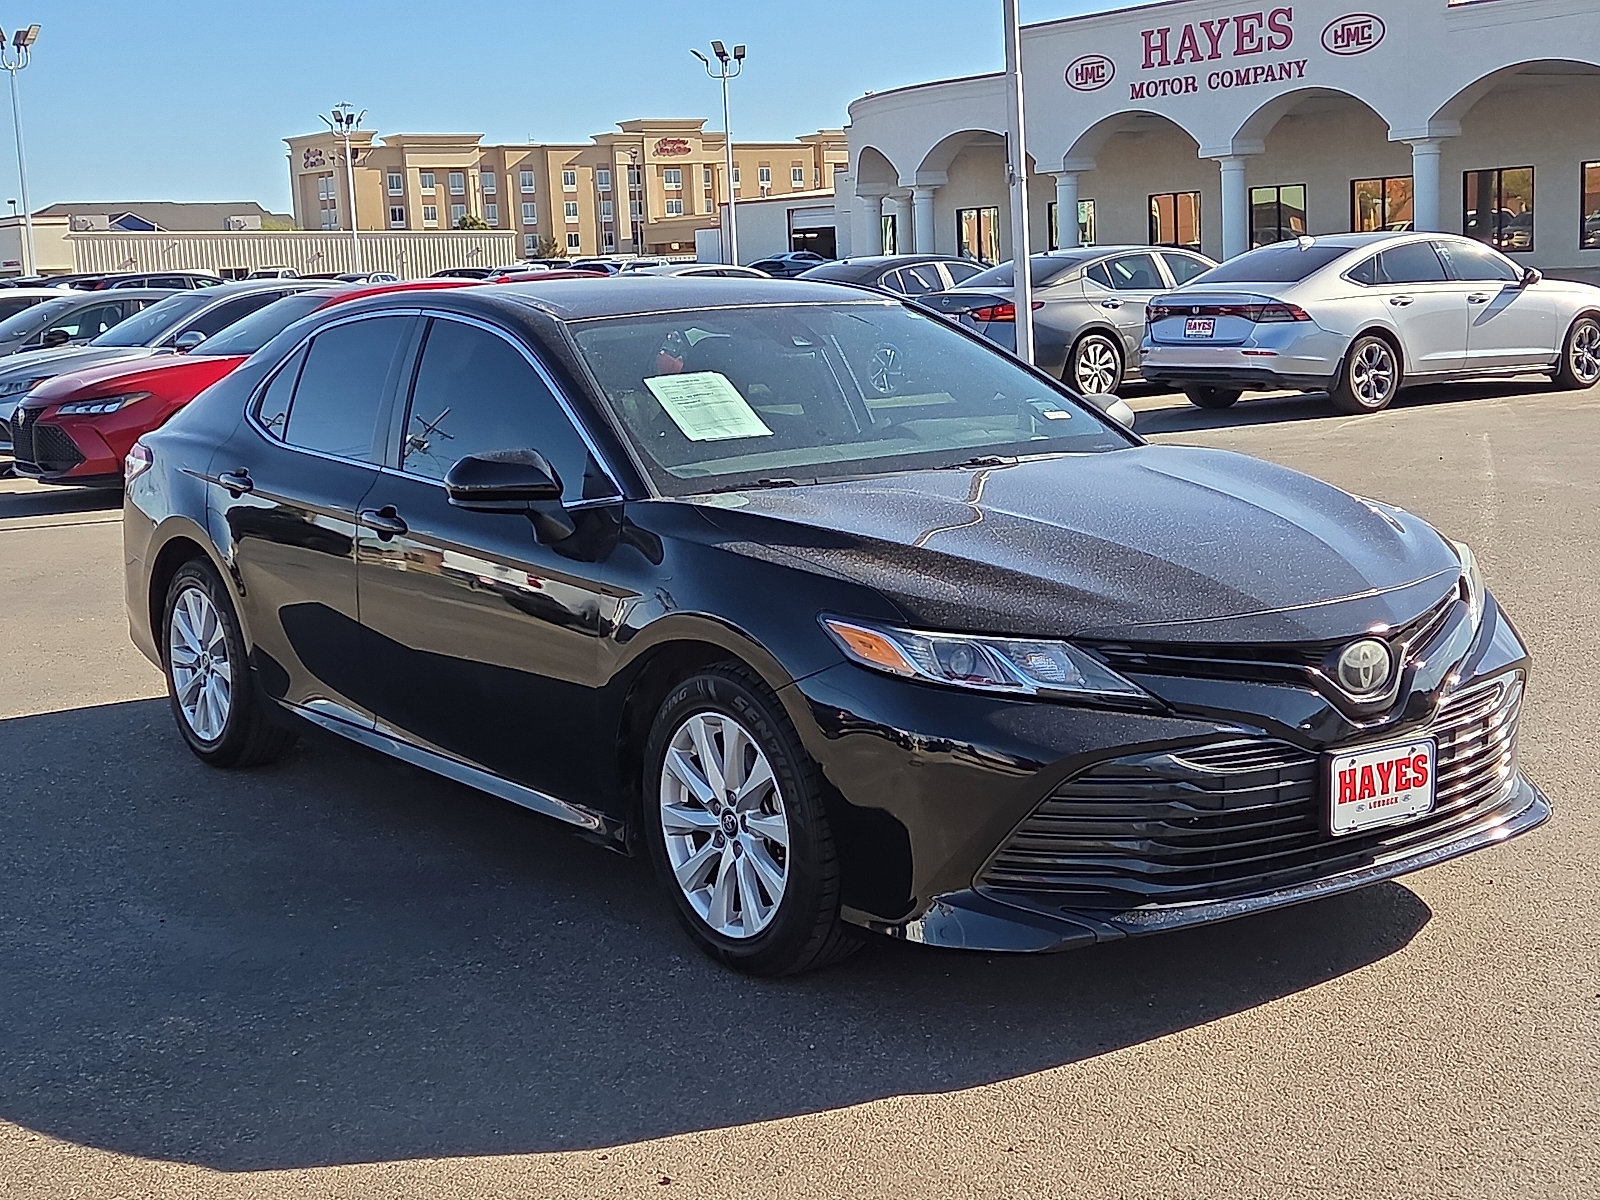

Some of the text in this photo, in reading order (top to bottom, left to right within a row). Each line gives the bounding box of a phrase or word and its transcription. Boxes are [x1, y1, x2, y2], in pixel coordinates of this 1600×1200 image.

[1140, 7, 1294, 69] HAYES
[1333, 19, 1373, 49] HMC
[1074, 60, 1106, 86] HMC
[1129, 59, 1308, 100] MOTOR COMPANY
[1187, 321, 1212, 330] HAYES
[1338, 753, 1429, 805] HAYES
